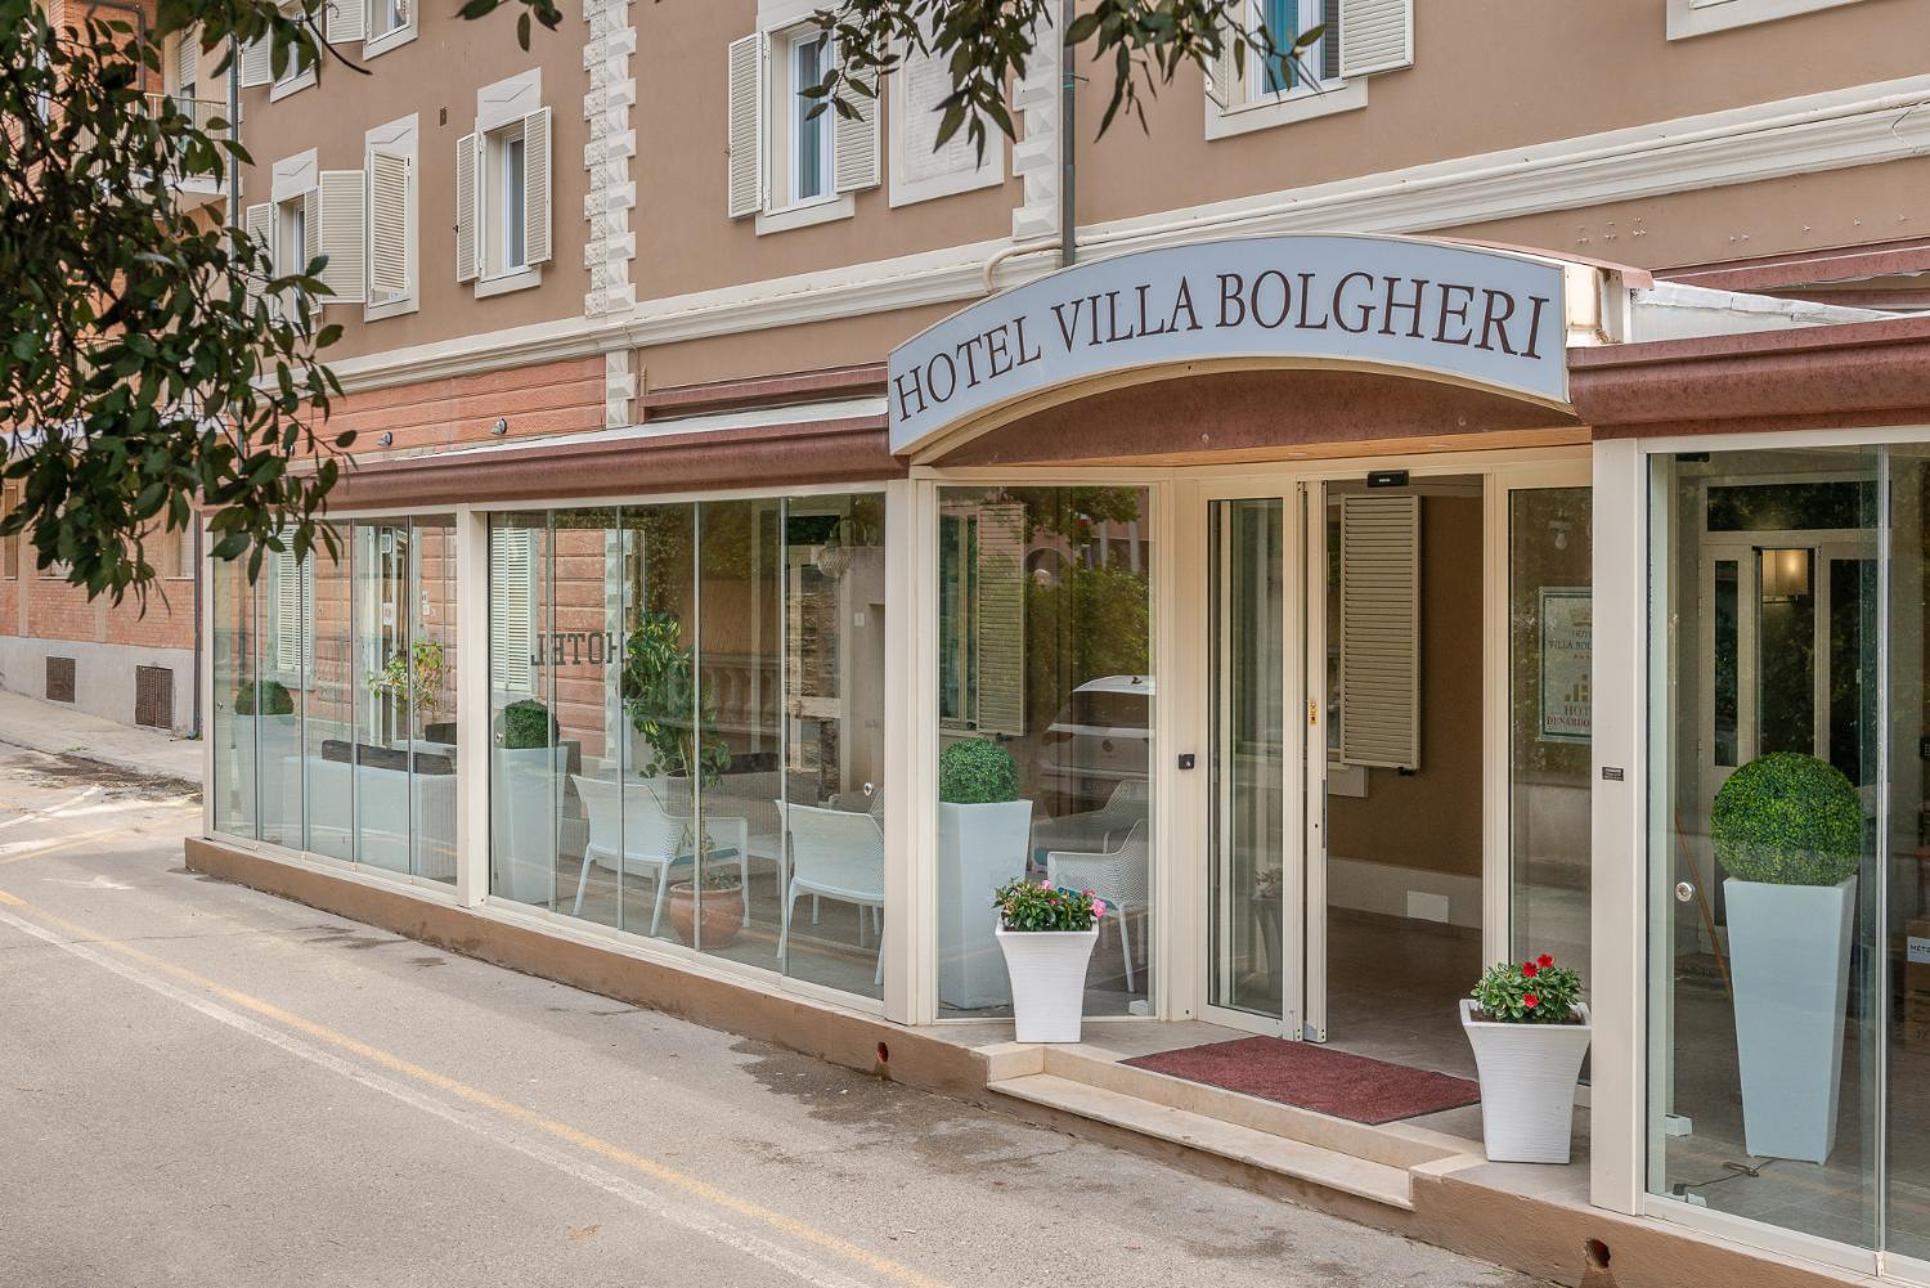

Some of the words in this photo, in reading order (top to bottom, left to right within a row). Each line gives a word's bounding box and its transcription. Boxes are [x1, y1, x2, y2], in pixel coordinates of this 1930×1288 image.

[892, 315, 1042, 422] HOTEL
[1050, 275, 1203, 354] VILLA
[1215, 269, 1551, 360] BOLGHERI
[1575, 640, 1592, 649] BOL
